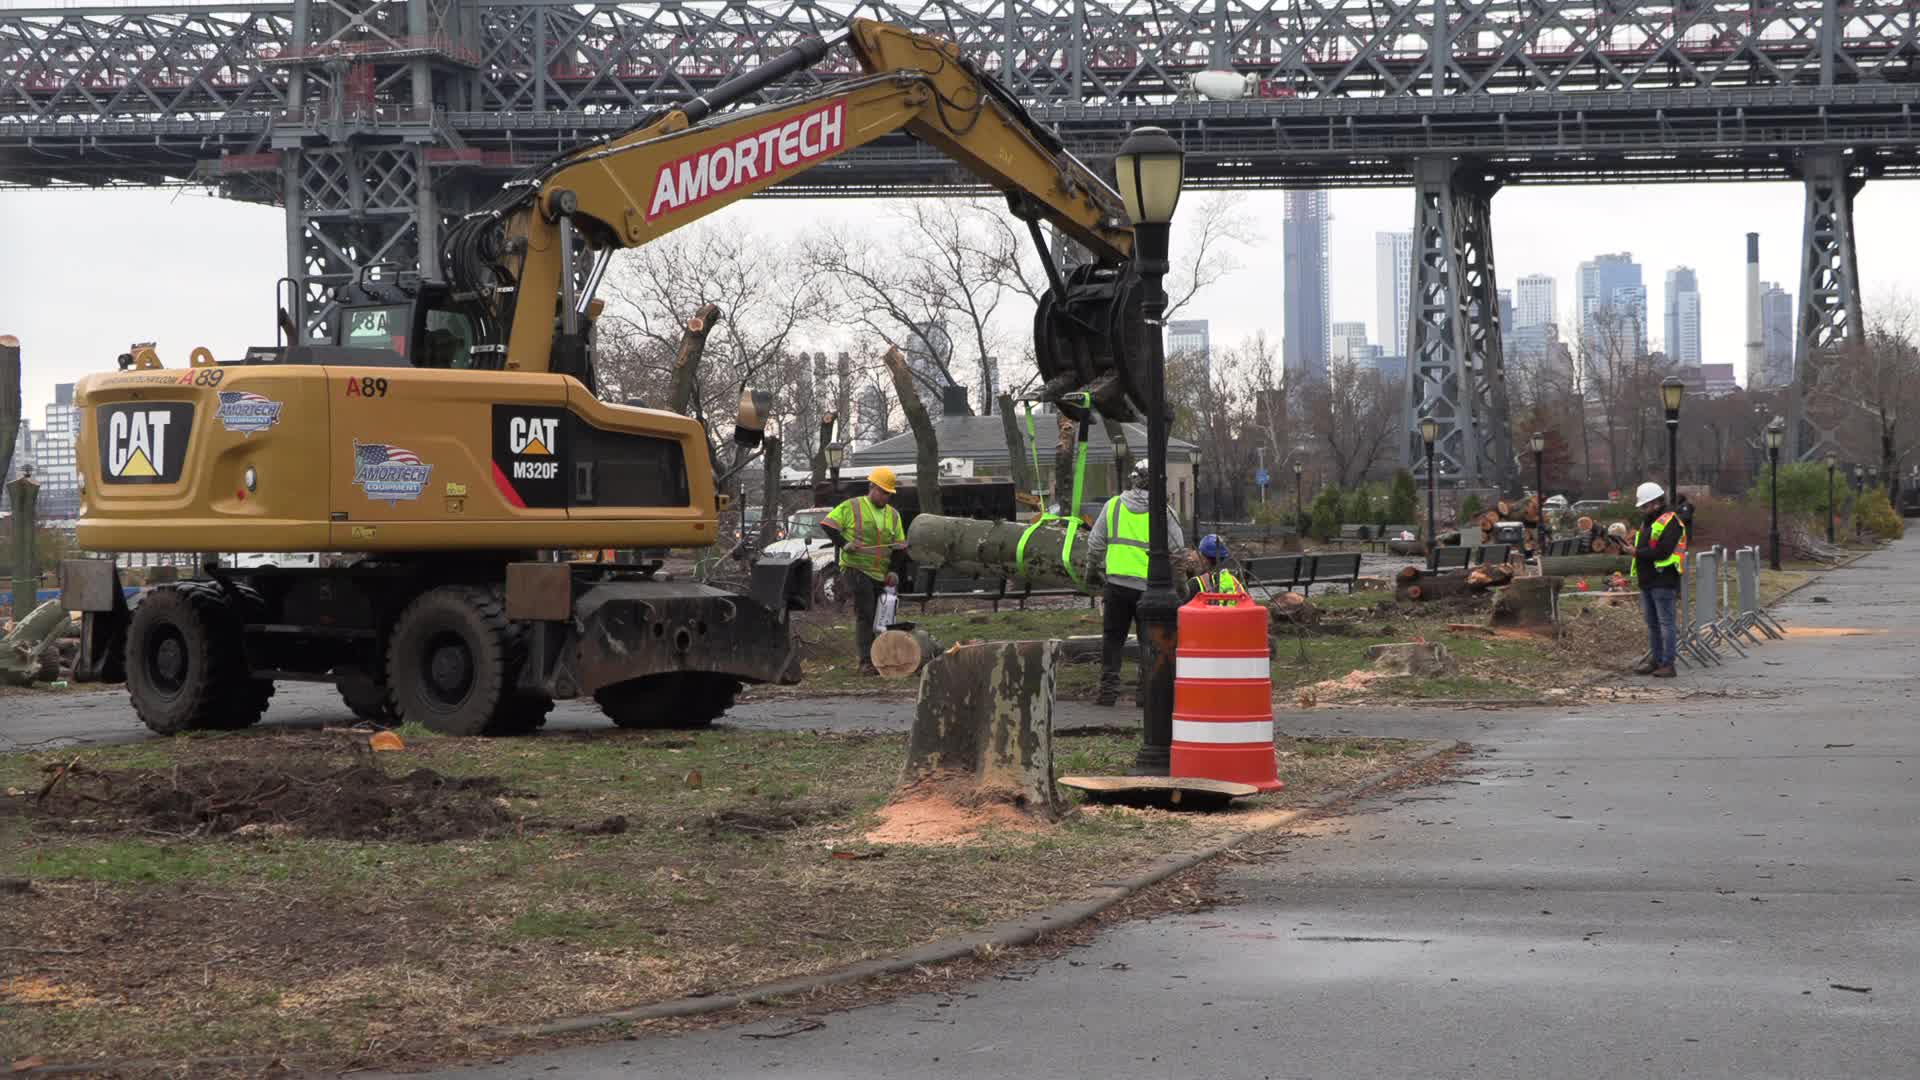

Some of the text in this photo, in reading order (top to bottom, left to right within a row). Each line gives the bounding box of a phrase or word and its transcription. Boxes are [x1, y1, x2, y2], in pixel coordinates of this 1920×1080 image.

[650, 104, 842, 216] AMORTECH
[179, 368, 225, 387] A89
[346, 376, 388, 398] A89
[109, 410, 171, 477] CAT
[510, 416, 559, 455] CAT
[359, 465, 430, 481] AMORTECH
[513, 461, 559, 479] M320F
